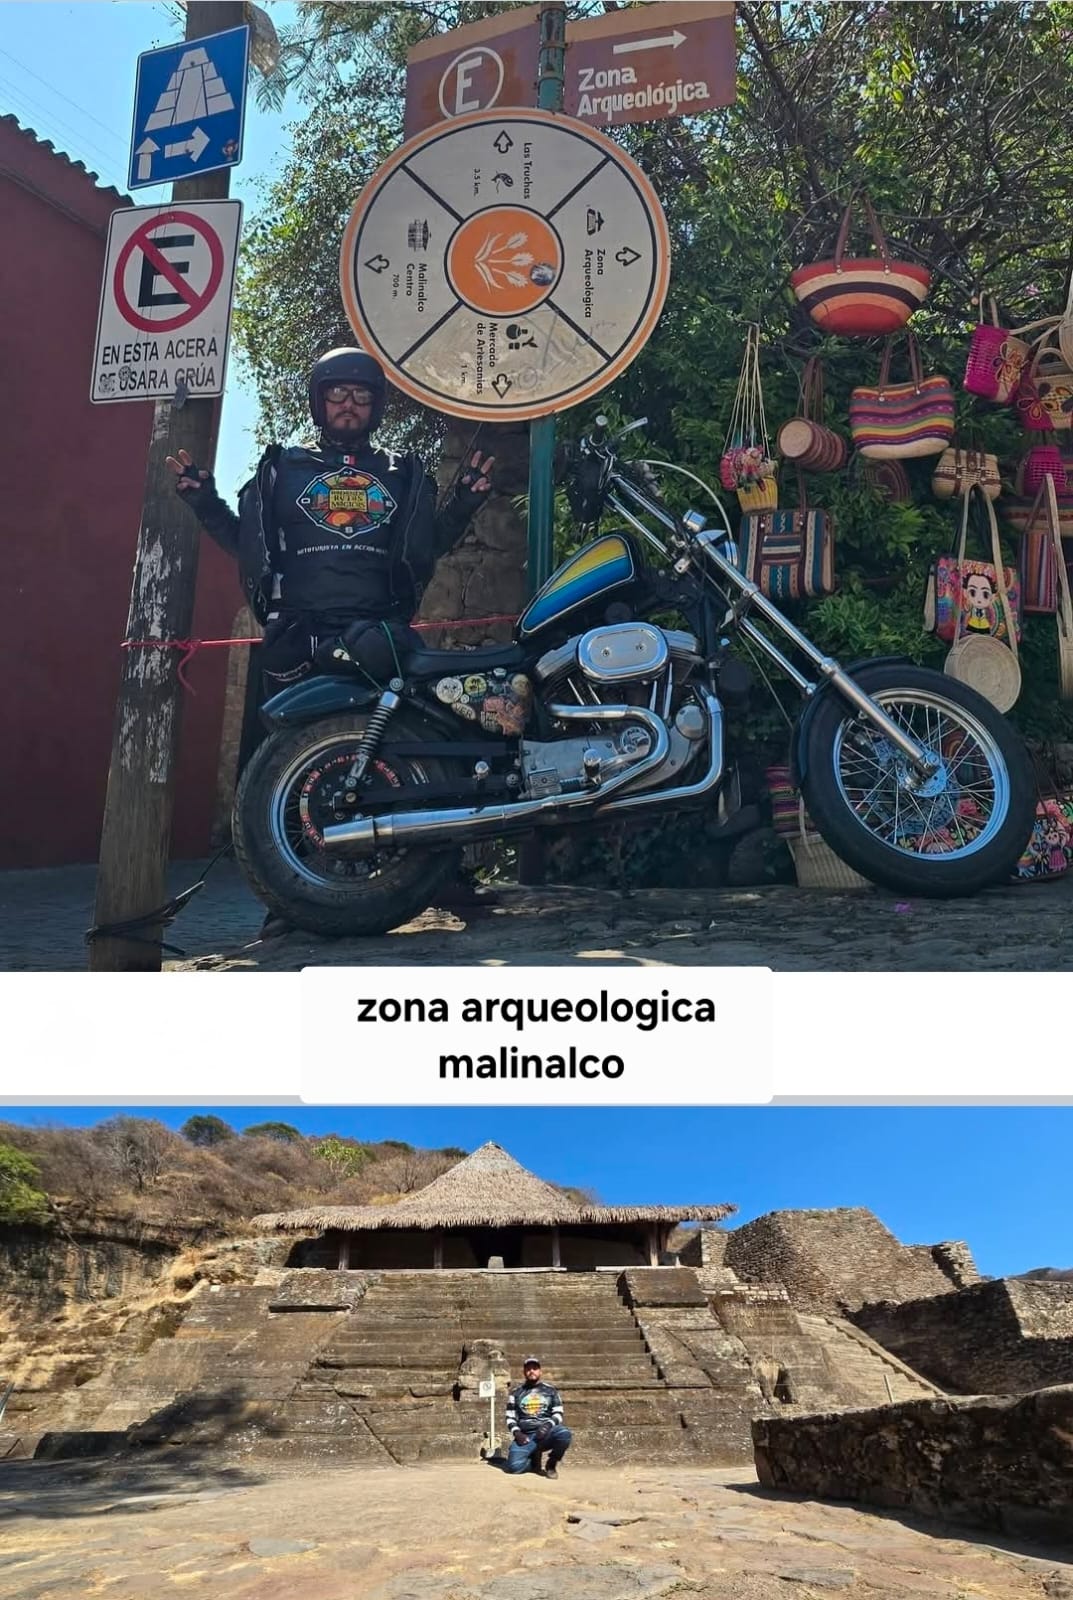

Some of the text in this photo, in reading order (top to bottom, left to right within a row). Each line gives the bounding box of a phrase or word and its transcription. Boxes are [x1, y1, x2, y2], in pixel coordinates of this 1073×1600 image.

[455, 55, 483, 114] E
[577, 64, 638, 92] Zona
[577, 79, 710, 121] Arqueológica
[523, 142, 533, 200] Las Truchas
[138, 234, 195, 308] E
[392, 273, 400, 288] 700
[406, 262, 416, 297] Centro
[596, 247, 606, 276] Zona
[417, 262, 428, 313] Malinalco
[583, 248, 594, 319] Arqueológica
[476, 322, 486, 335] de
[489, 322, 499, 368] Mercado
[101, 336, 218, 366] EN ESTA ACERA
